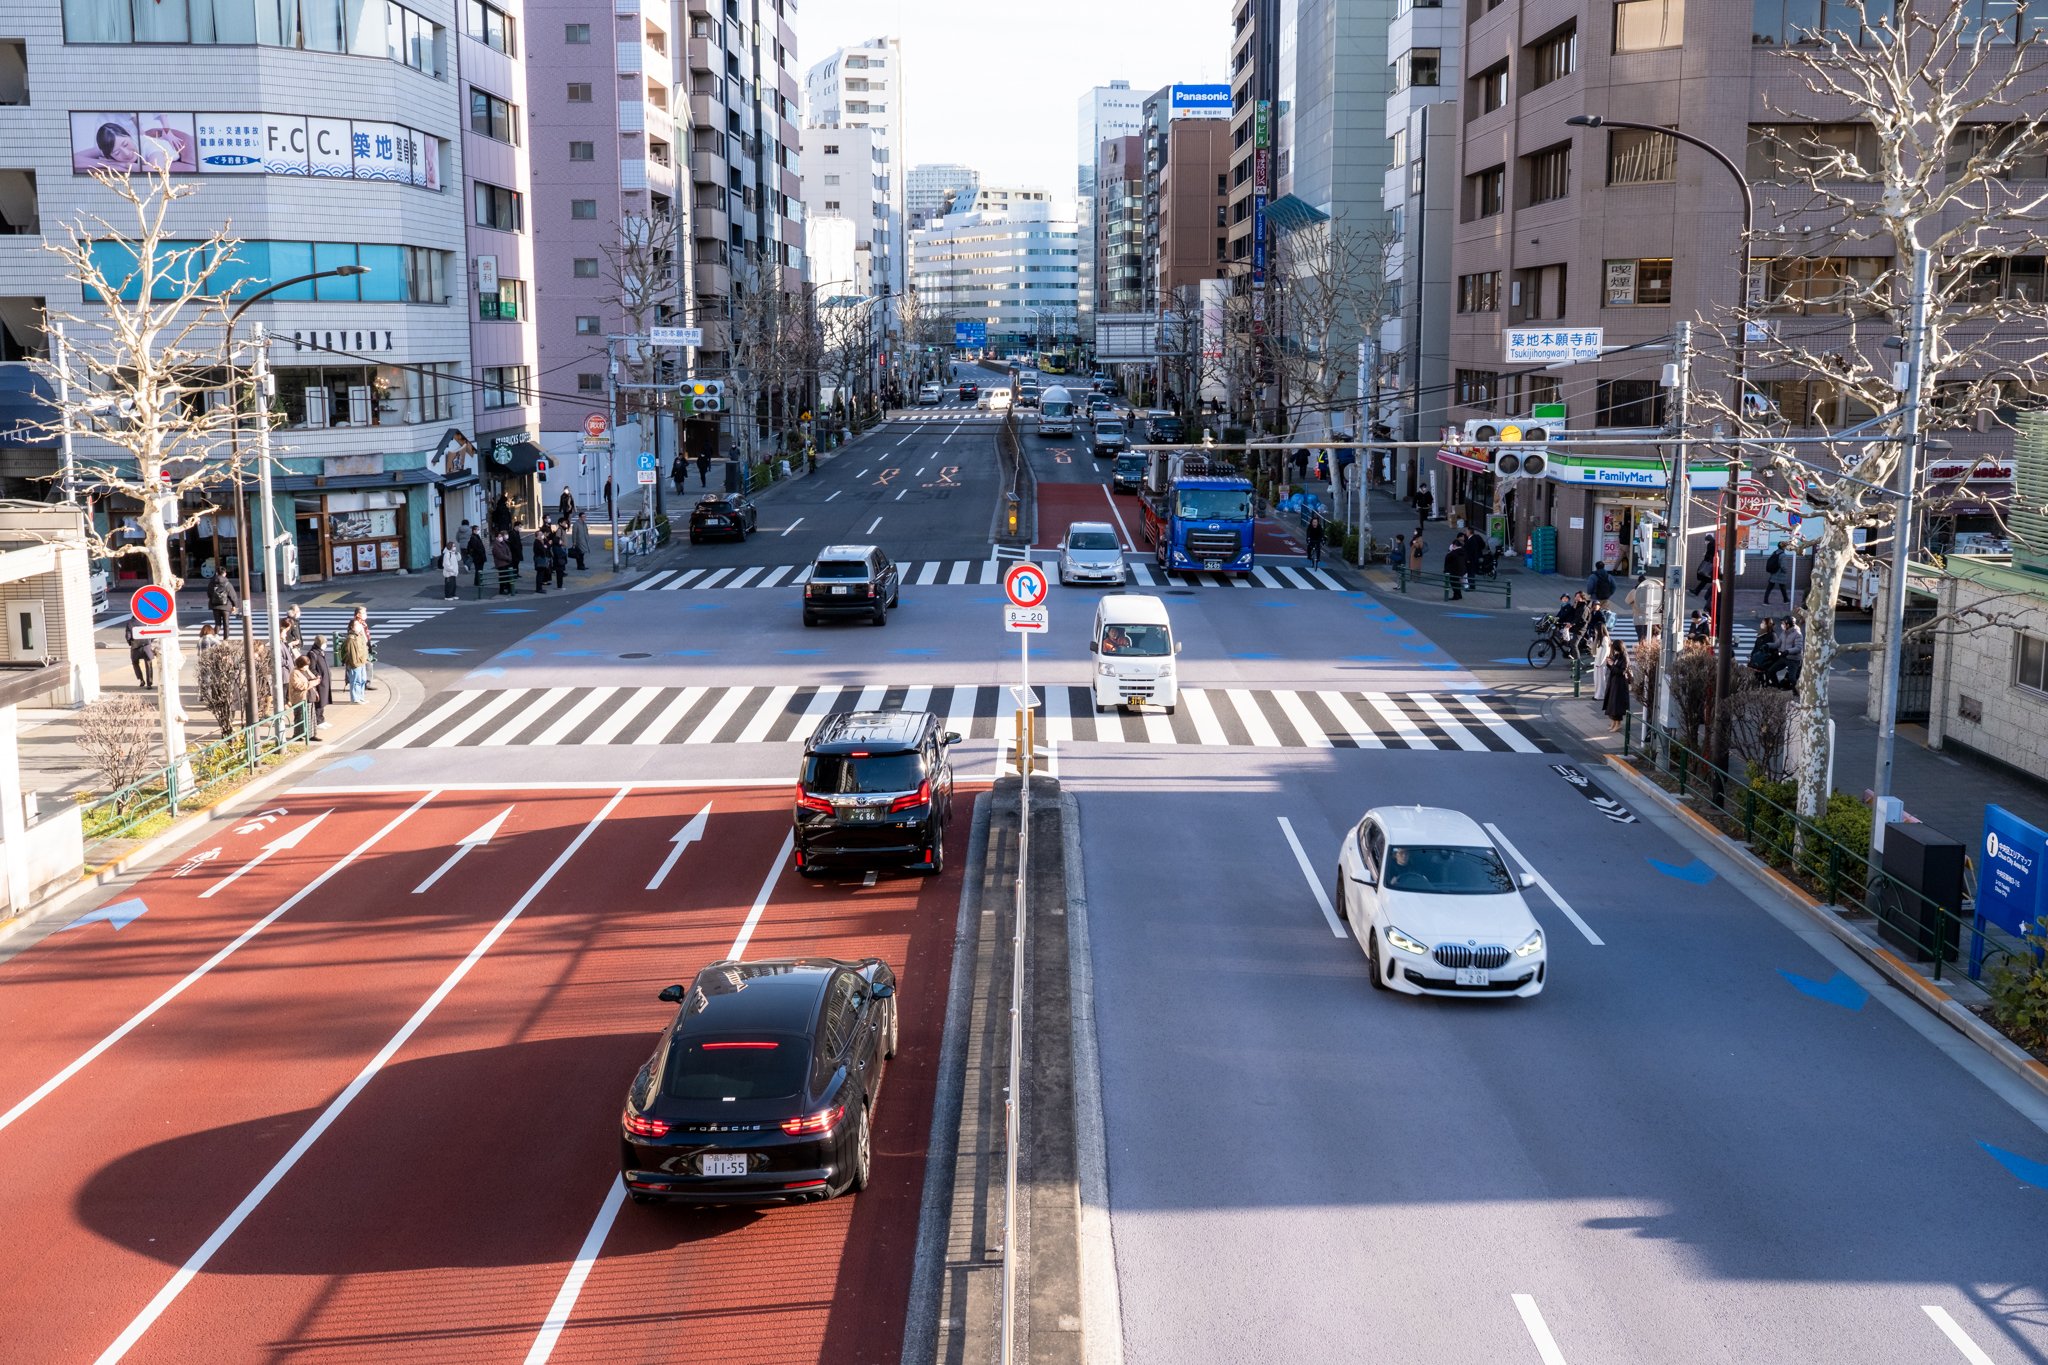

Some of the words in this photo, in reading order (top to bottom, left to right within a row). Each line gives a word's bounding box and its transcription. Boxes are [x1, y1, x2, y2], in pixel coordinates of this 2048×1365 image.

[1176, 91, 1229, 101] Panasonic
[1257, 103, 1266, 145] 築地ビル
[199, 126, 259, 135] 労災・交通事故
[200, 138, 260, 147] 健康保険取扱い
[1610, 265, 1632, 299] 喫煙所
[653, 329, 699, 338] 築地本願寺前
[1511, 332, 1598, 347] 築地本願寺前
[1510, 348, 1570, 360] Tsukijihongwanji
[1572, 347, 1598, 358] Temple
[1599, 470, 1653, 484] FamilyMart
[714, 1162, 745, 1174] 11-55
